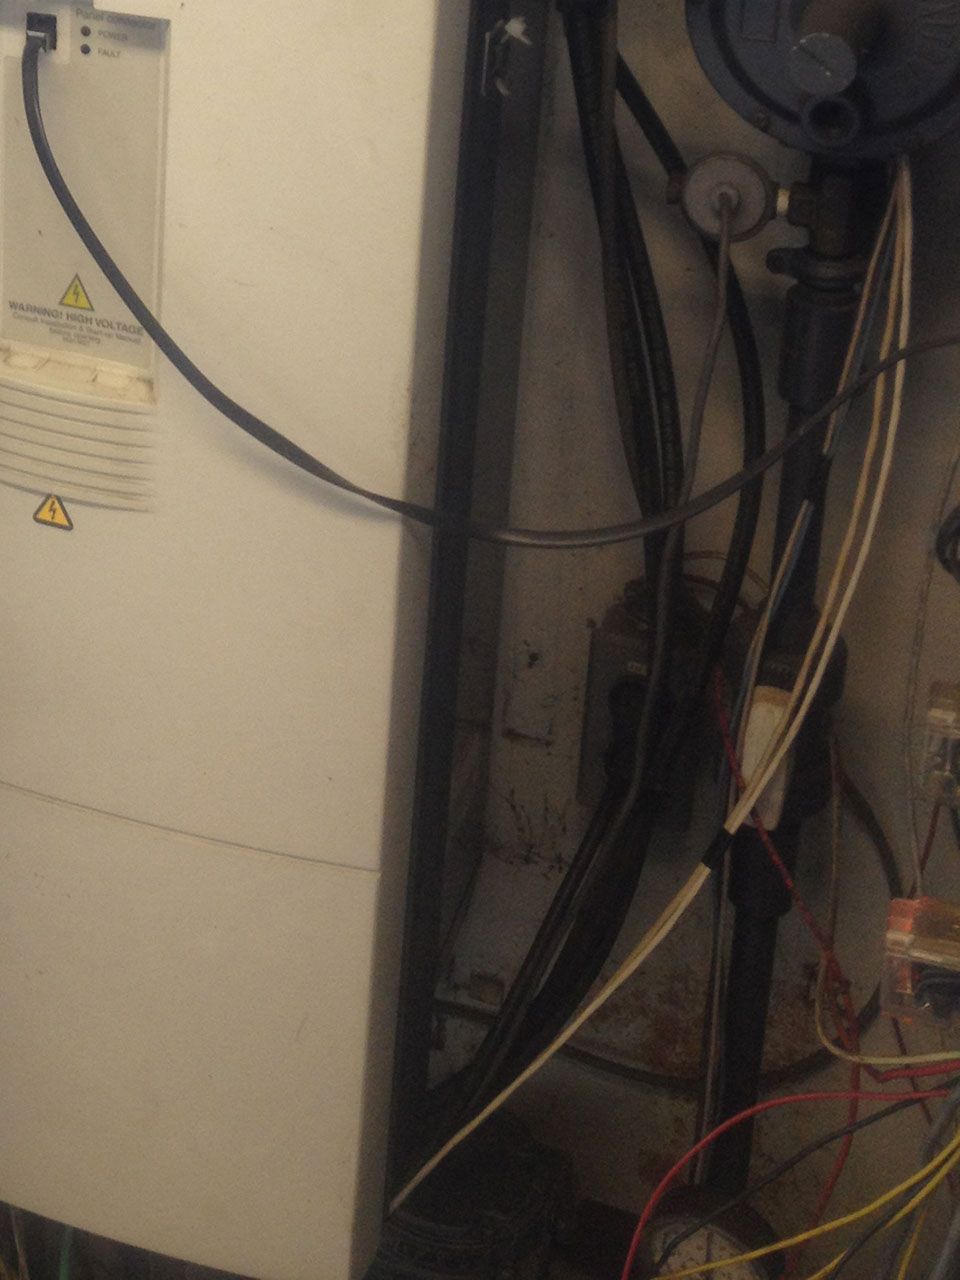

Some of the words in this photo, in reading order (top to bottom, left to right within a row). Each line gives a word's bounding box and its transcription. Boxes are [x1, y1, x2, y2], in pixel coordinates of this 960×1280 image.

[97, 29, 129, 42] POWER
[97, 47, 122, 58] FAULT
[8, 300, 63, 320] WARNING!
[65, 311, 94, 326] HIGH
[95, 317, 144, 336] VOLTAGE
